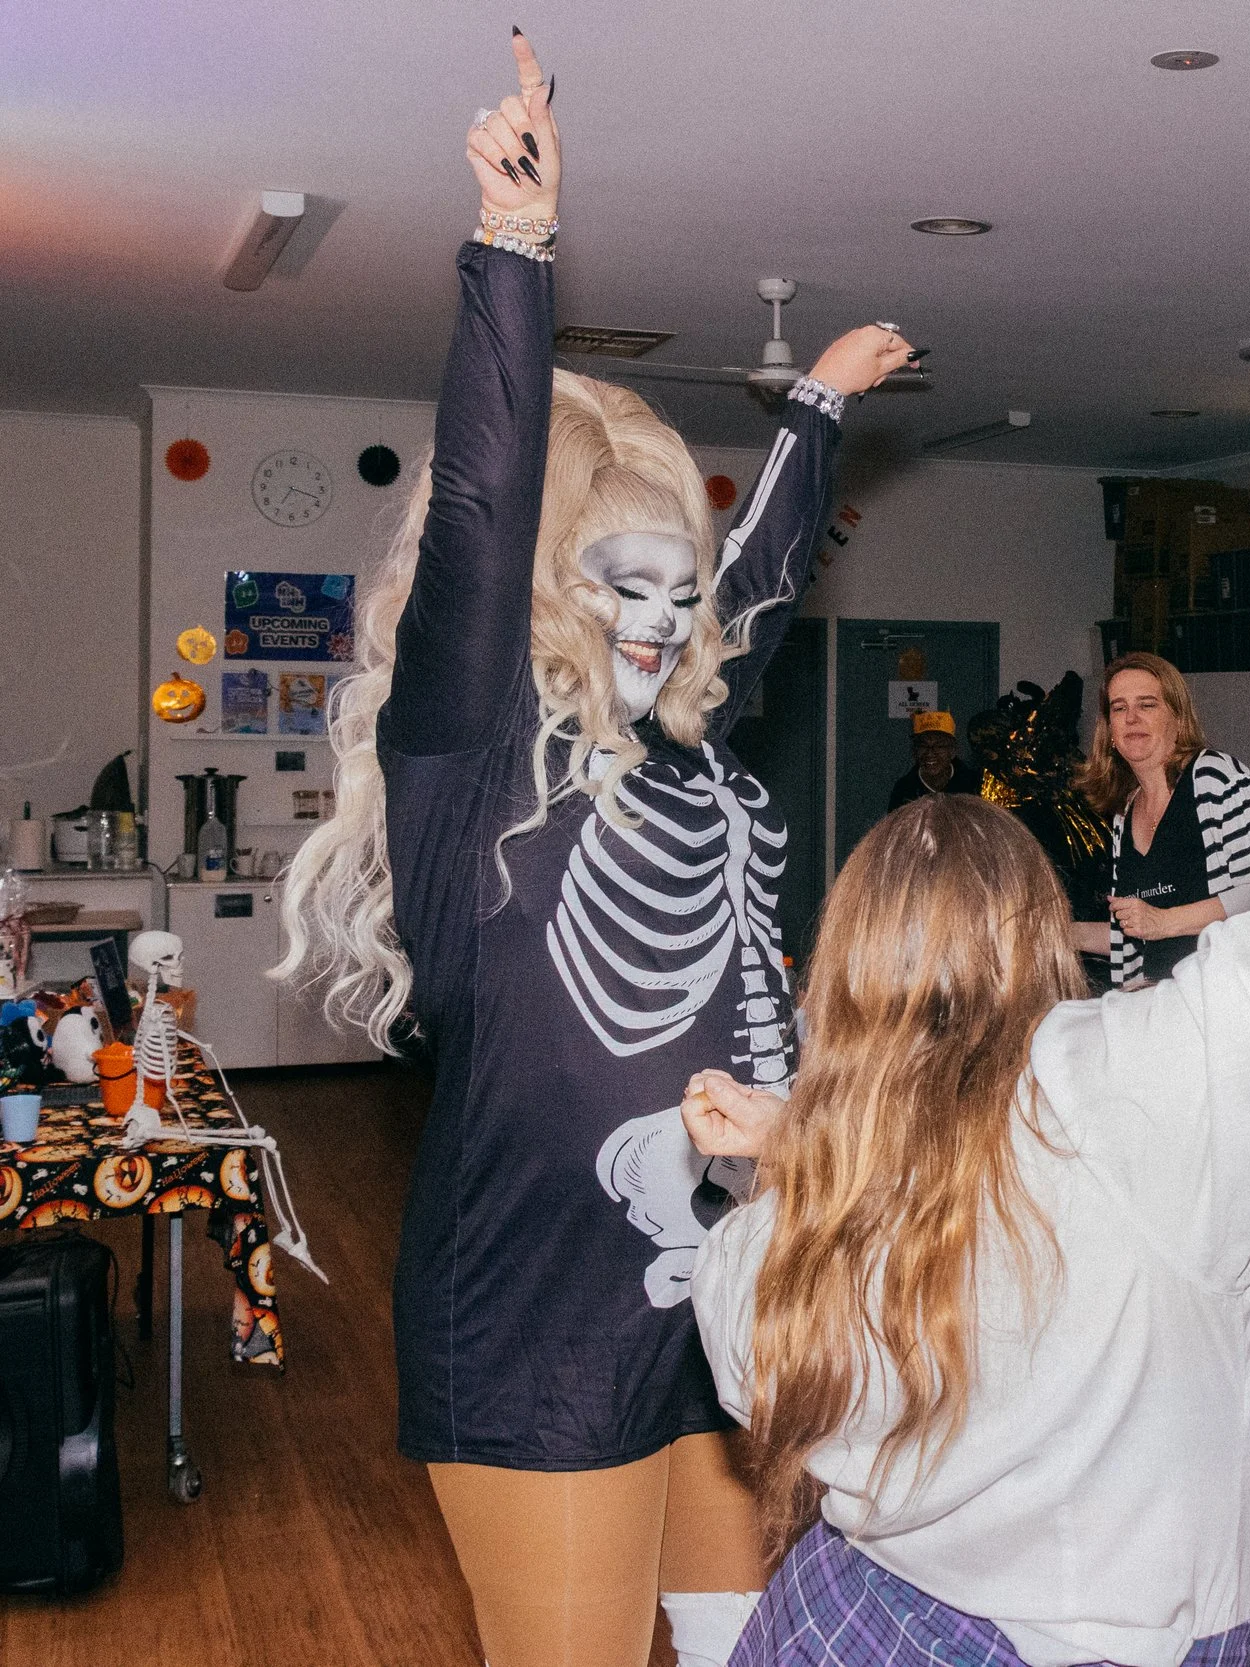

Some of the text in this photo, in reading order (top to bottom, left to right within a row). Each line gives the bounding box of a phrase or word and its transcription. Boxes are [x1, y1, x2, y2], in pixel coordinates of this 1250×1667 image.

[289, 456, 298, 466] 12
[314, 471, 321, 481] 2
[260, 482, 267, 492] 9
[263, 497, 270, 506] 8
[288, 512, 295, 521] 6
[303, 509, 310, 518] 5
[251, 617, 329, 631] UPCOMING
[261, 634, 318, 647] EVENTS
[1141, 882, 1176, 898] murder.
[161, 1151, 210, 1187] Halloween
[32, 1161, 81, 1201] Halloween
